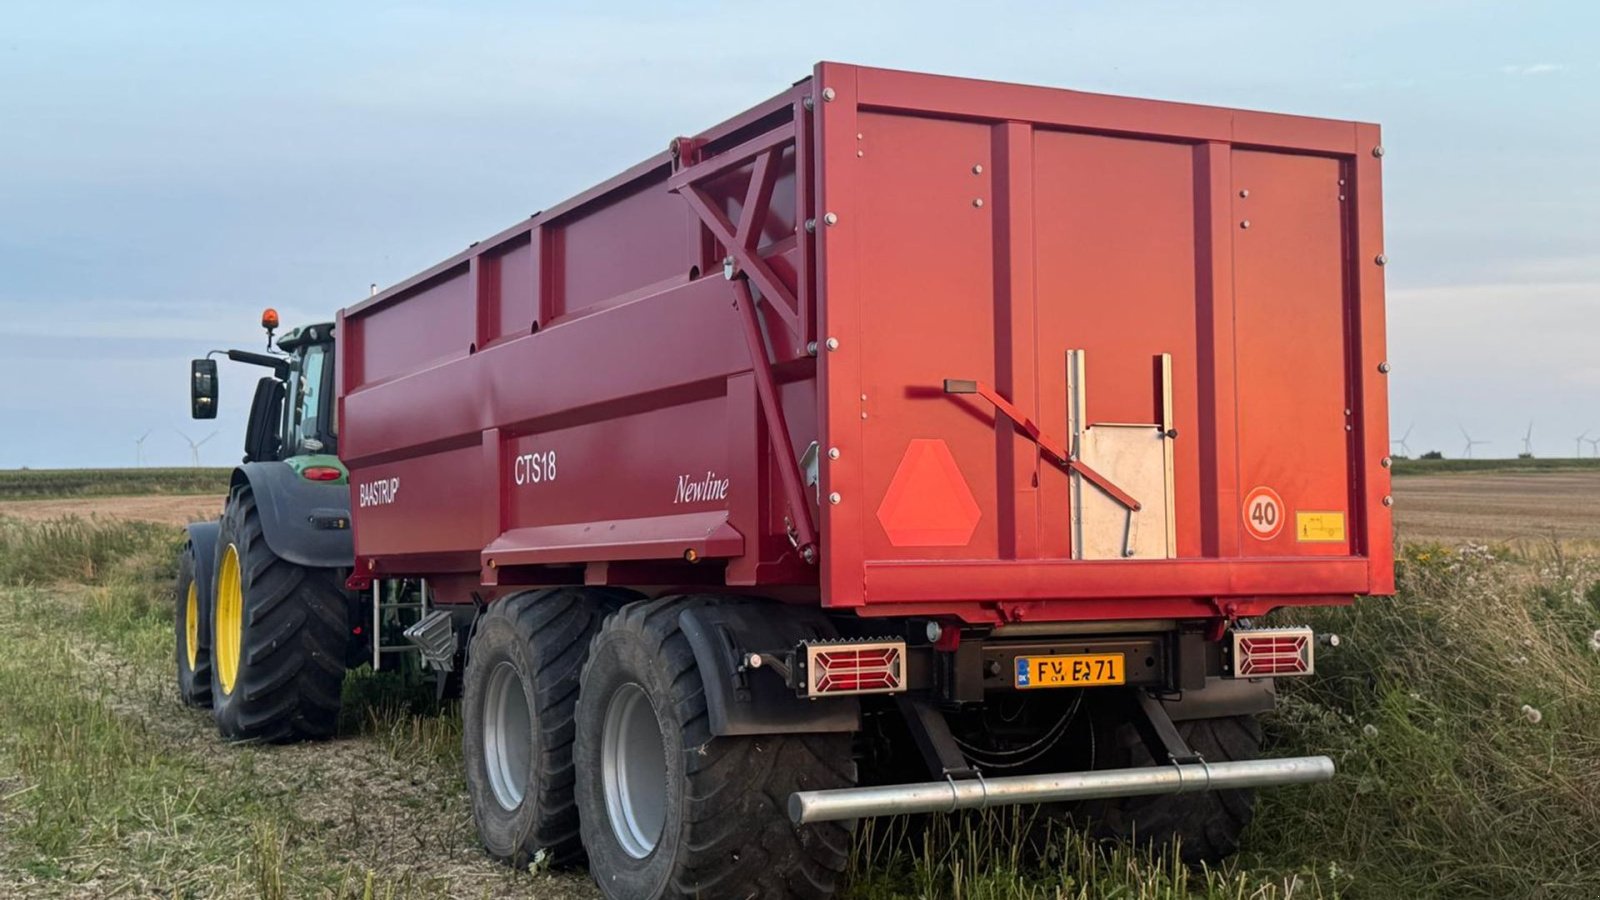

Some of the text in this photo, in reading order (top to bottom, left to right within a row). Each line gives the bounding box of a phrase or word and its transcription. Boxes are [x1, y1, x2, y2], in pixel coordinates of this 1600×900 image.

[515, 450, 556, 486] CTS18
[673, 471, 729, 504] Newline
[1252, 502, 1276, 526] 40
